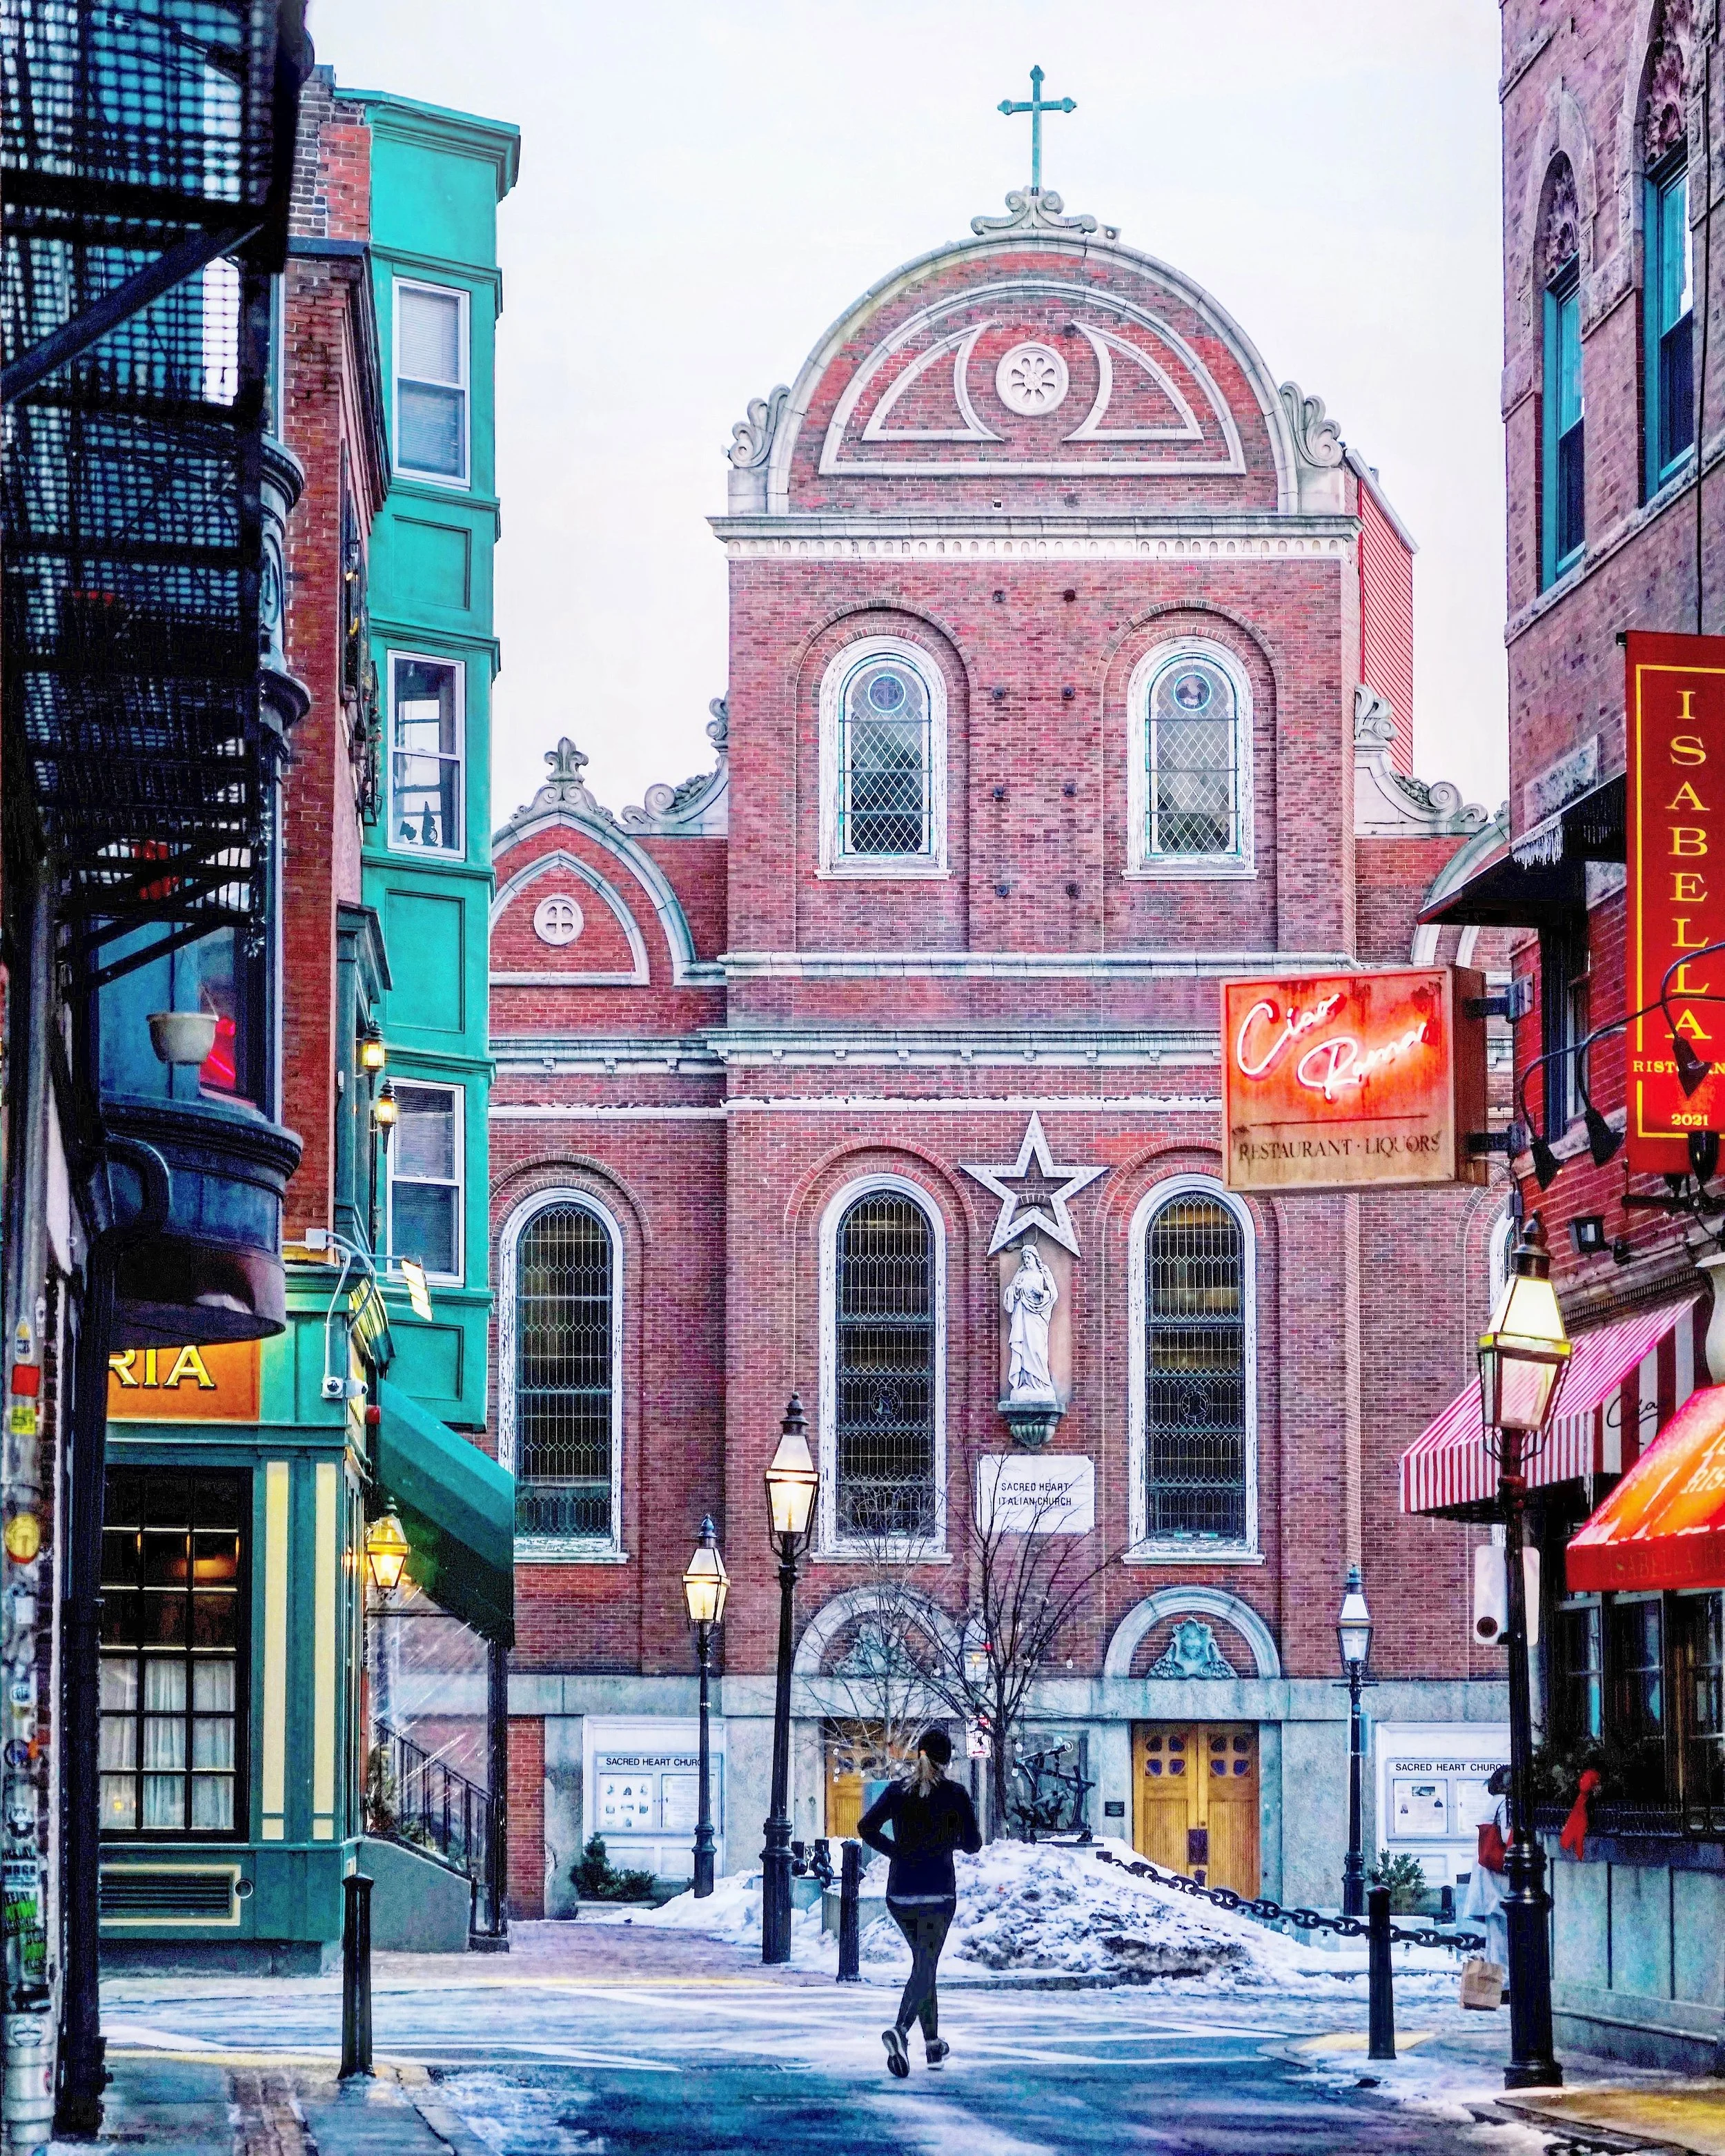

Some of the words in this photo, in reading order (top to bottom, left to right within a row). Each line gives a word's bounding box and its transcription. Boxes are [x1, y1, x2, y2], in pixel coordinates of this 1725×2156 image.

[1665, 690, 1711, 1041] ISABELLA
[1237, 992, 1341, 1076] Ciao
[1297, 1021, 1430, 1101] Roma
[1670, 1113, 1709, 1126] 2021
[1238, 1137, 1353, 1162] RESTAURANT
[1365, 1133, 1441, 1157] LIQUORS
[1001, 1482, 1036, 1491] SACRED
[1039, 1482, 1070, 1491] HEART
[998, 1497, 1035, 1505] ITALIAN
[1037, 1497, 1072, 1506] CHURCH
[606, 1758, 640, 1766] SACRED
[642, 1758, 671, 1766] HEART
[1395, 1763, 1432, 1772] SACRED
[1437, 1763, 1466, 1772] HEART
